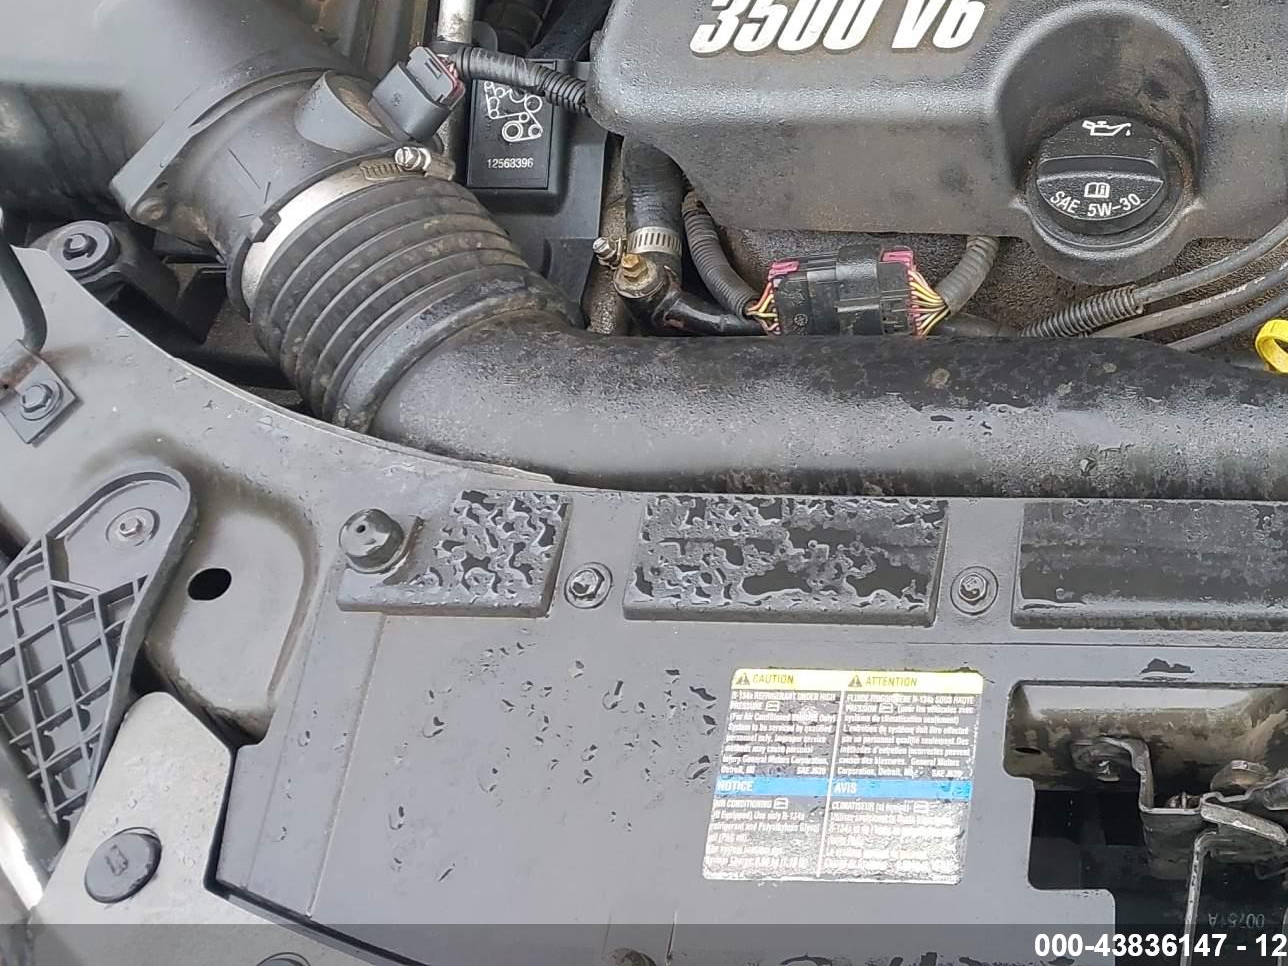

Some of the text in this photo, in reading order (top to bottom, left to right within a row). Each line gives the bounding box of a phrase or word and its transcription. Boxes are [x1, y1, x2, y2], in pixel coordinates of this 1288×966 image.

[1050, 191, 1141, 217] SAE 5W-30
[752, 674, 794, 684] CAUTION
[865, 676, 918, 687] ATTENTION
[718, 781, 753, 791] NOTICE
[833, 782, 857, 794] AVIS
